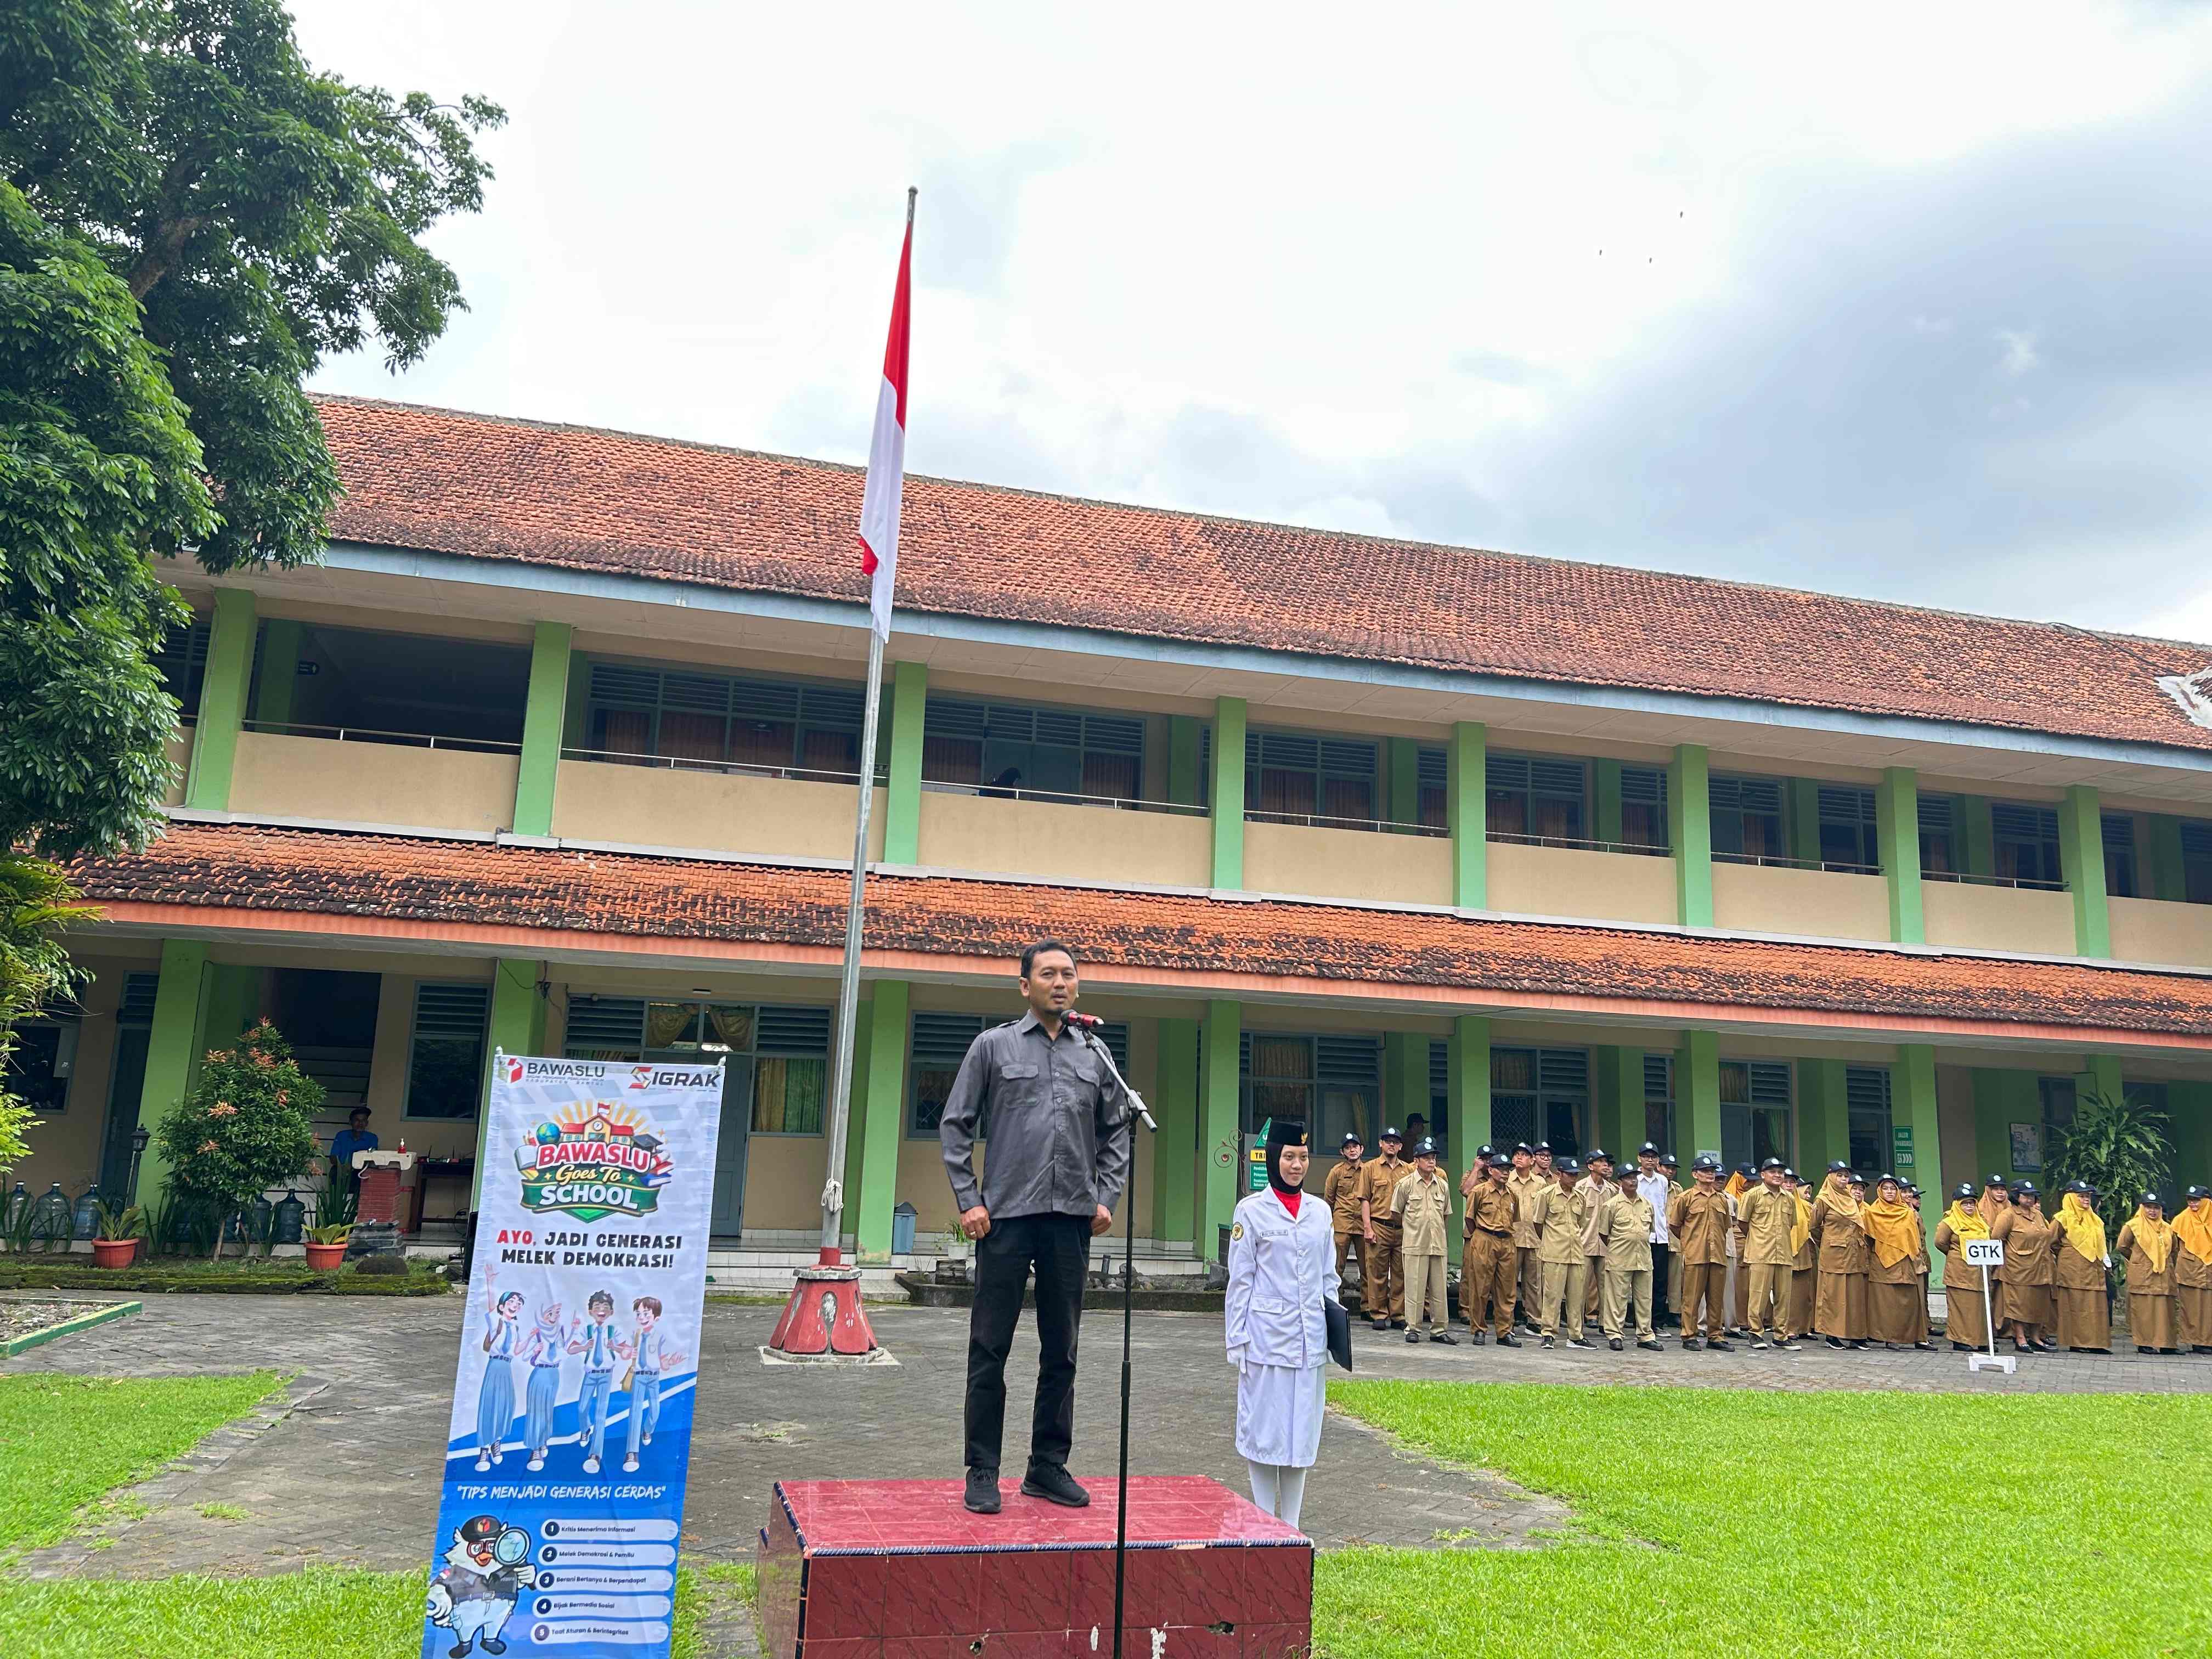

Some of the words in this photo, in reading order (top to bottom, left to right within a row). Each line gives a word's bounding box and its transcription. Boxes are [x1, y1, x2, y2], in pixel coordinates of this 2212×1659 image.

[527, 1063, 605, 1077] BAWASLU
[538, 1143, 648, 1171] BAWASLU
[555, 1164, 598, 1186] Goes
[600, 1166, 622, 1183] To
[539, 1184, 639, 1209] SCHOOL
[496, 1229, 536, 1246] AYO,
[544, 1232, 589, 1247] JADI
[596, 1233, 682, 1249] GENERASI
[501, 1249, 556, 1265] MELEK
[563, 1251, 674, 1268] DEMOKRASI!
[1968, 1245, 2000, 1257] GTK
[457, 1485, 487, 1499] "TIPS
[490, 1485, 547, 1499] MENJADI
[550, 1485, 611, 1499] GENERASI
[614, 1484, 666, 1499] CERDAS"
[593, 1628, 629, 1636] Berintegritas
